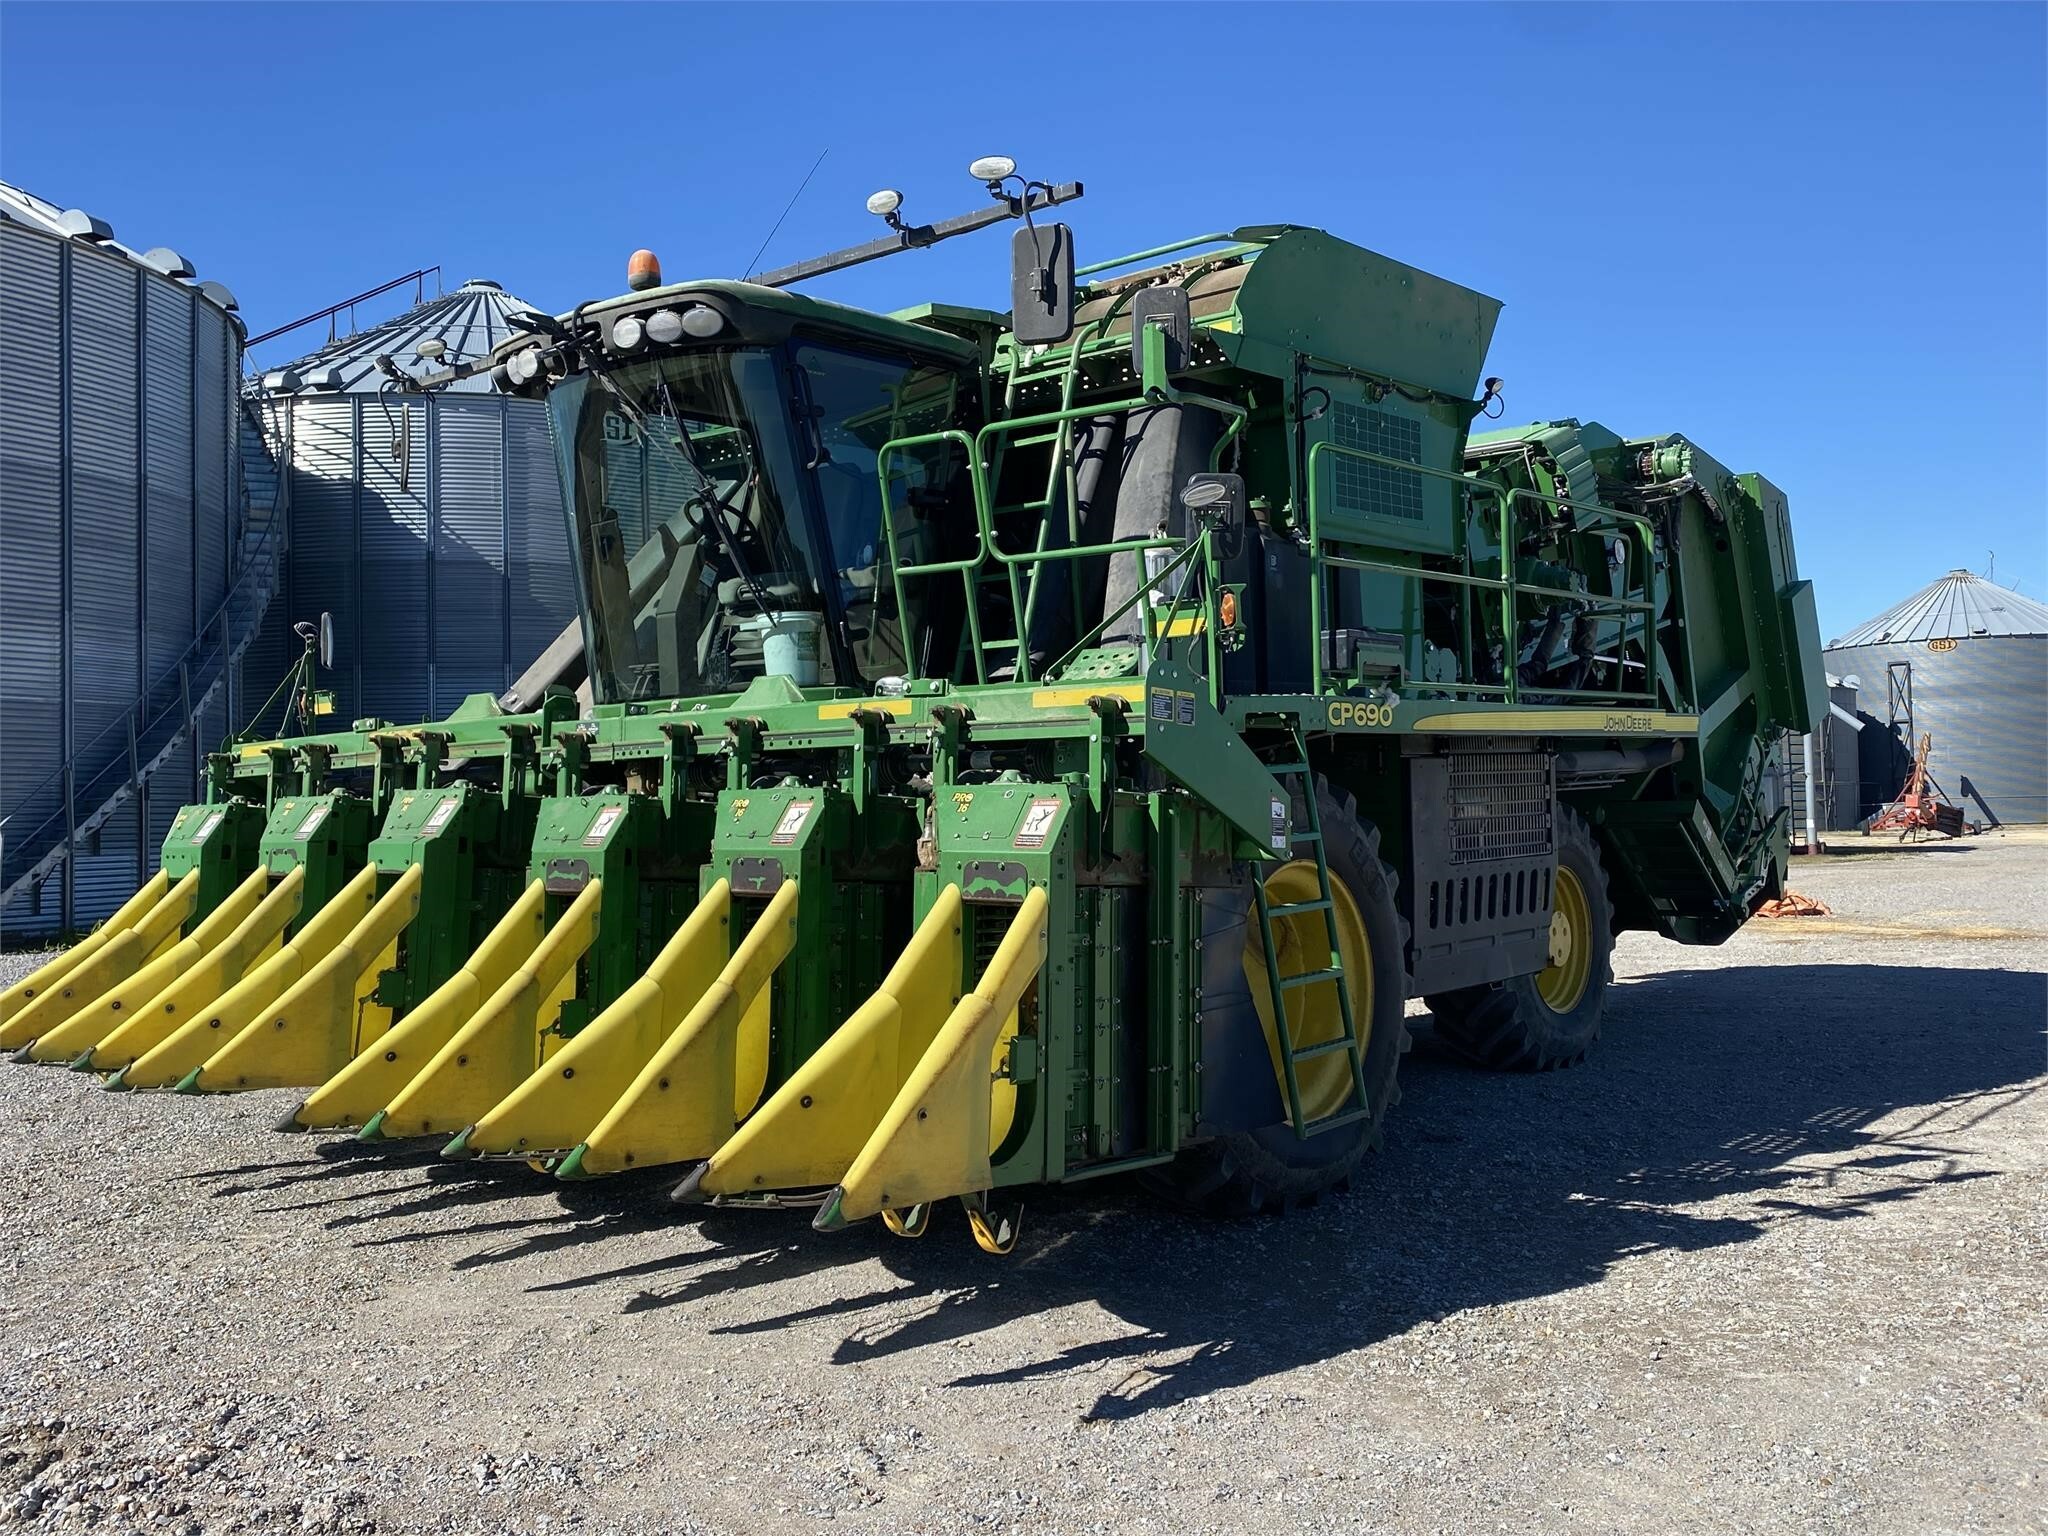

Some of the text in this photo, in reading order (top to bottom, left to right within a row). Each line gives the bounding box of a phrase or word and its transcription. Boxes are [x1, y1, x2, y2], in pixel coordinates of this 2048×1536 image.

[605, 415, 633, 440] SI
[1931, 640, 1953, 650] GSI
[1328, 702, 1393, 727] CP690
[1603, 714, 1653, 730] JOHN DEERE
[951, 792, 975, 803] PRO
[956, 803, 970, 813] 16
